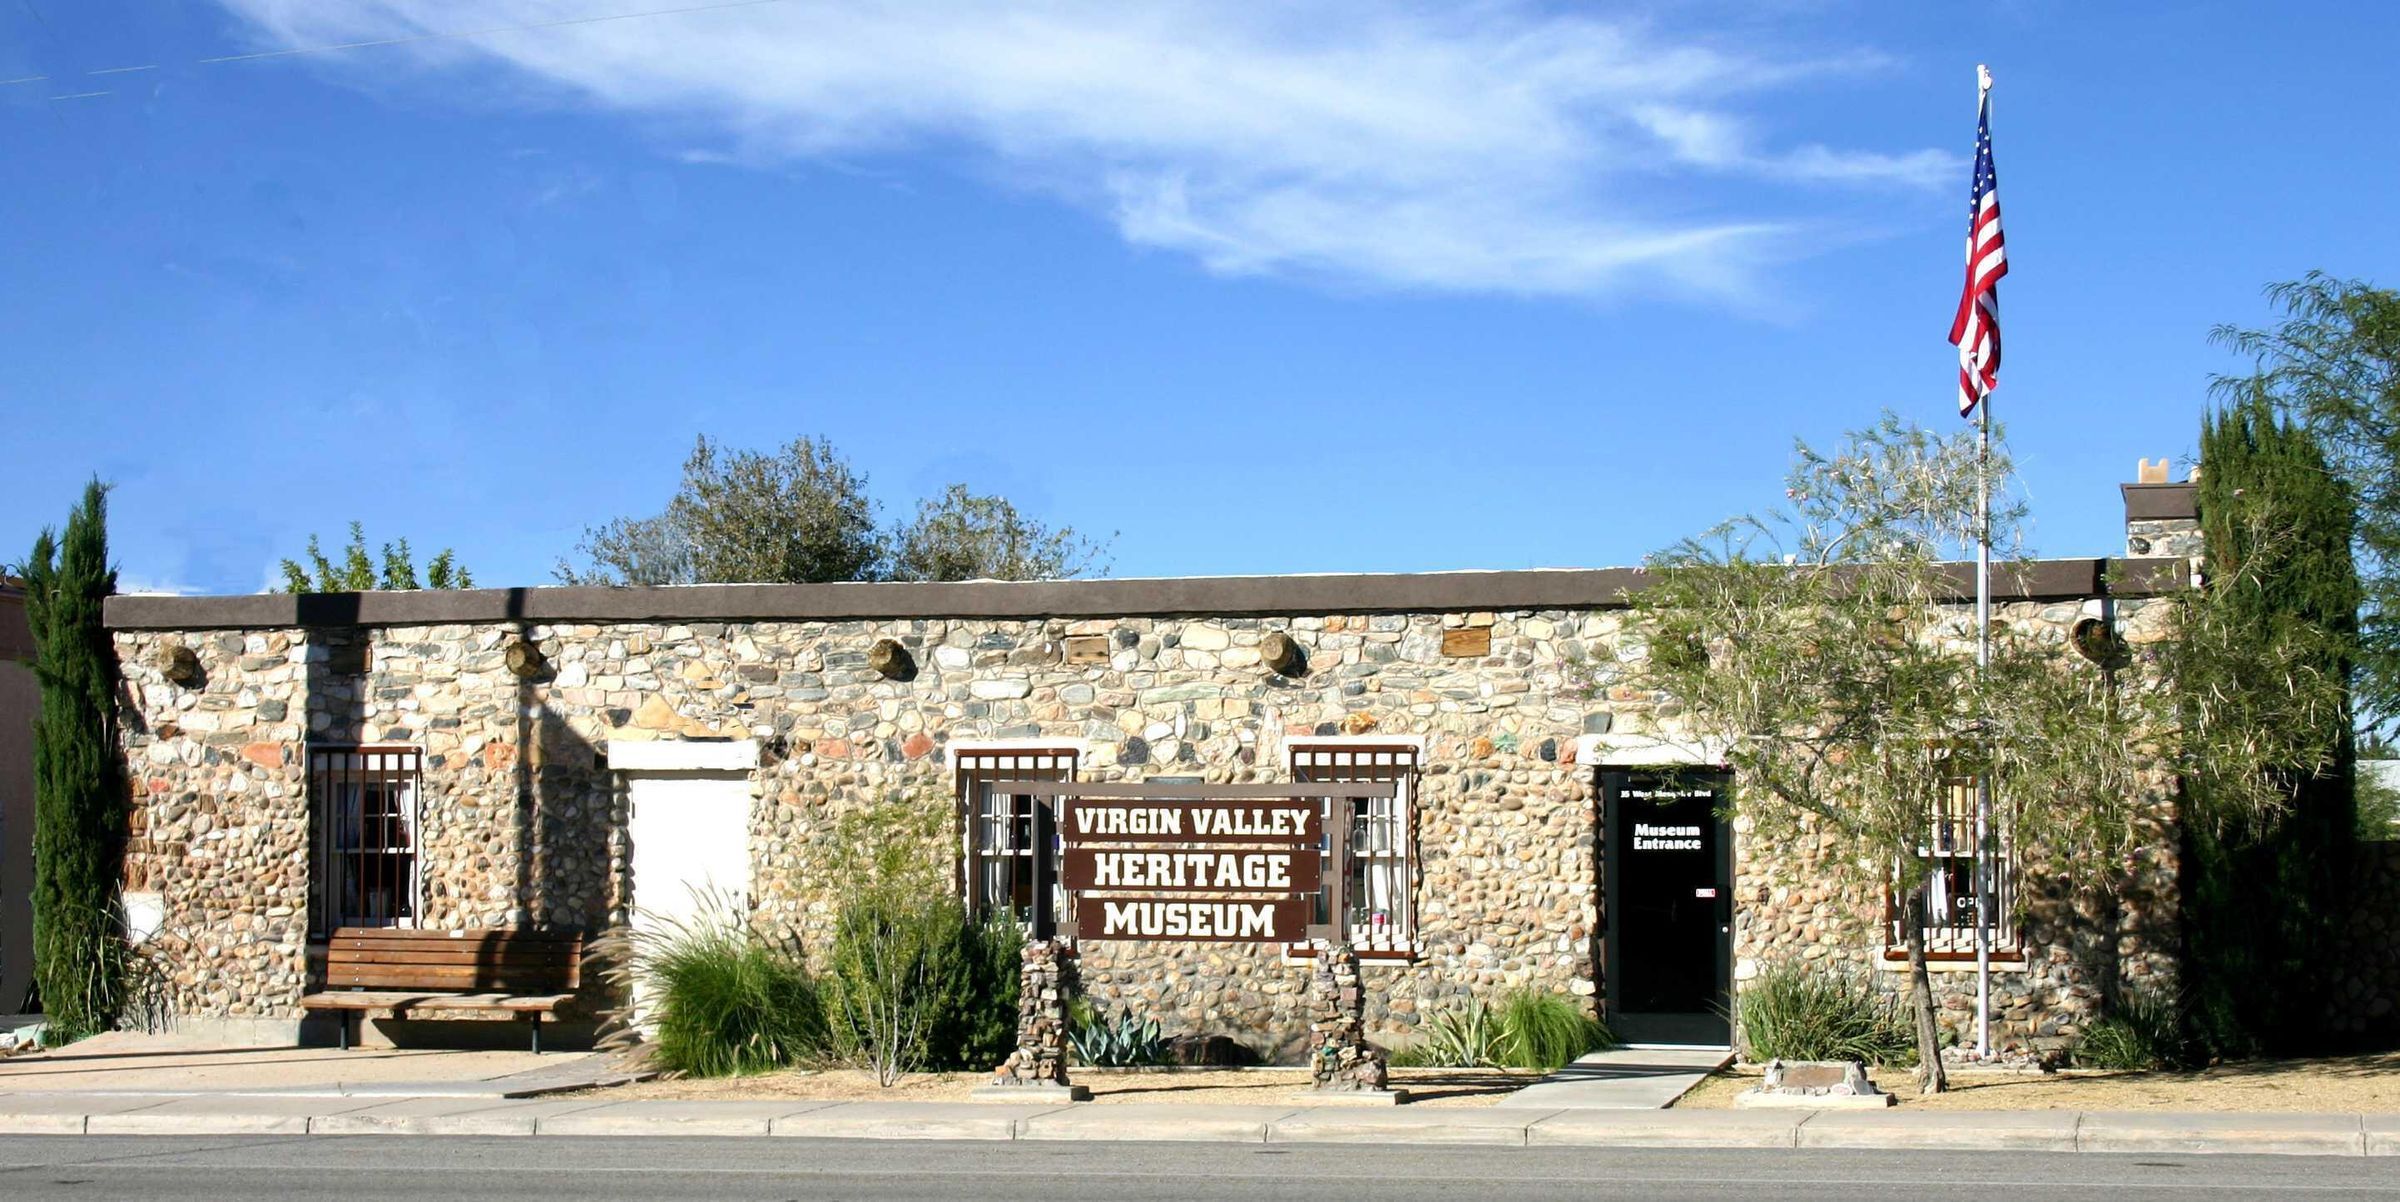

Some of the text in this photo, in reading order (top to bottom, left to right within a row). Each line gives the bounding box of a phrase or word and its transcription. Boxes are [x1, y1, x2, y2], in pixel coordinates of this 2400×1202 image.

[1694, 790, 1712, 798] Blvd
[1074, 807, 1311, 836] VIRGIN VALLEY
[1634, 823, 1701, 836] Museum
[1633, 836, 1702, 850] Entrance
[1094, 853, 1291, 888] HERITAGE
[1103, 901, 1275, 937] MUSEUM
